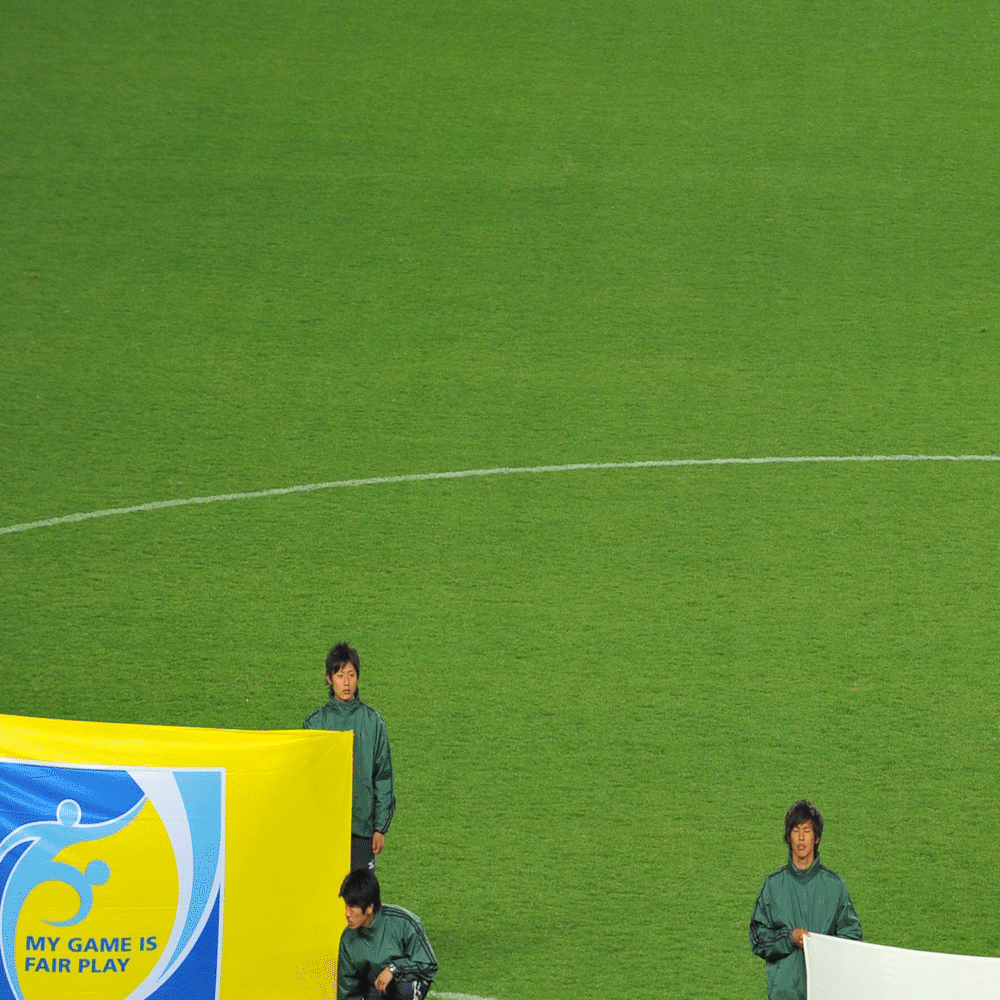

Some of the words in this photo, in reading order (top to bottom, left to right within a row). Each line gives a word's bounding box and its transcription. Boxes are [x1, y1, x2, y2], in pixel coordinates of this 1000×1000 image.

[26, 936, 59, 952] MY
[68, 936, 132, 953] GAME
[140, 936, 157, 951] IS
[24, 957, 72, 973] FAIR
[78, 958, 131, 973] PLAY
